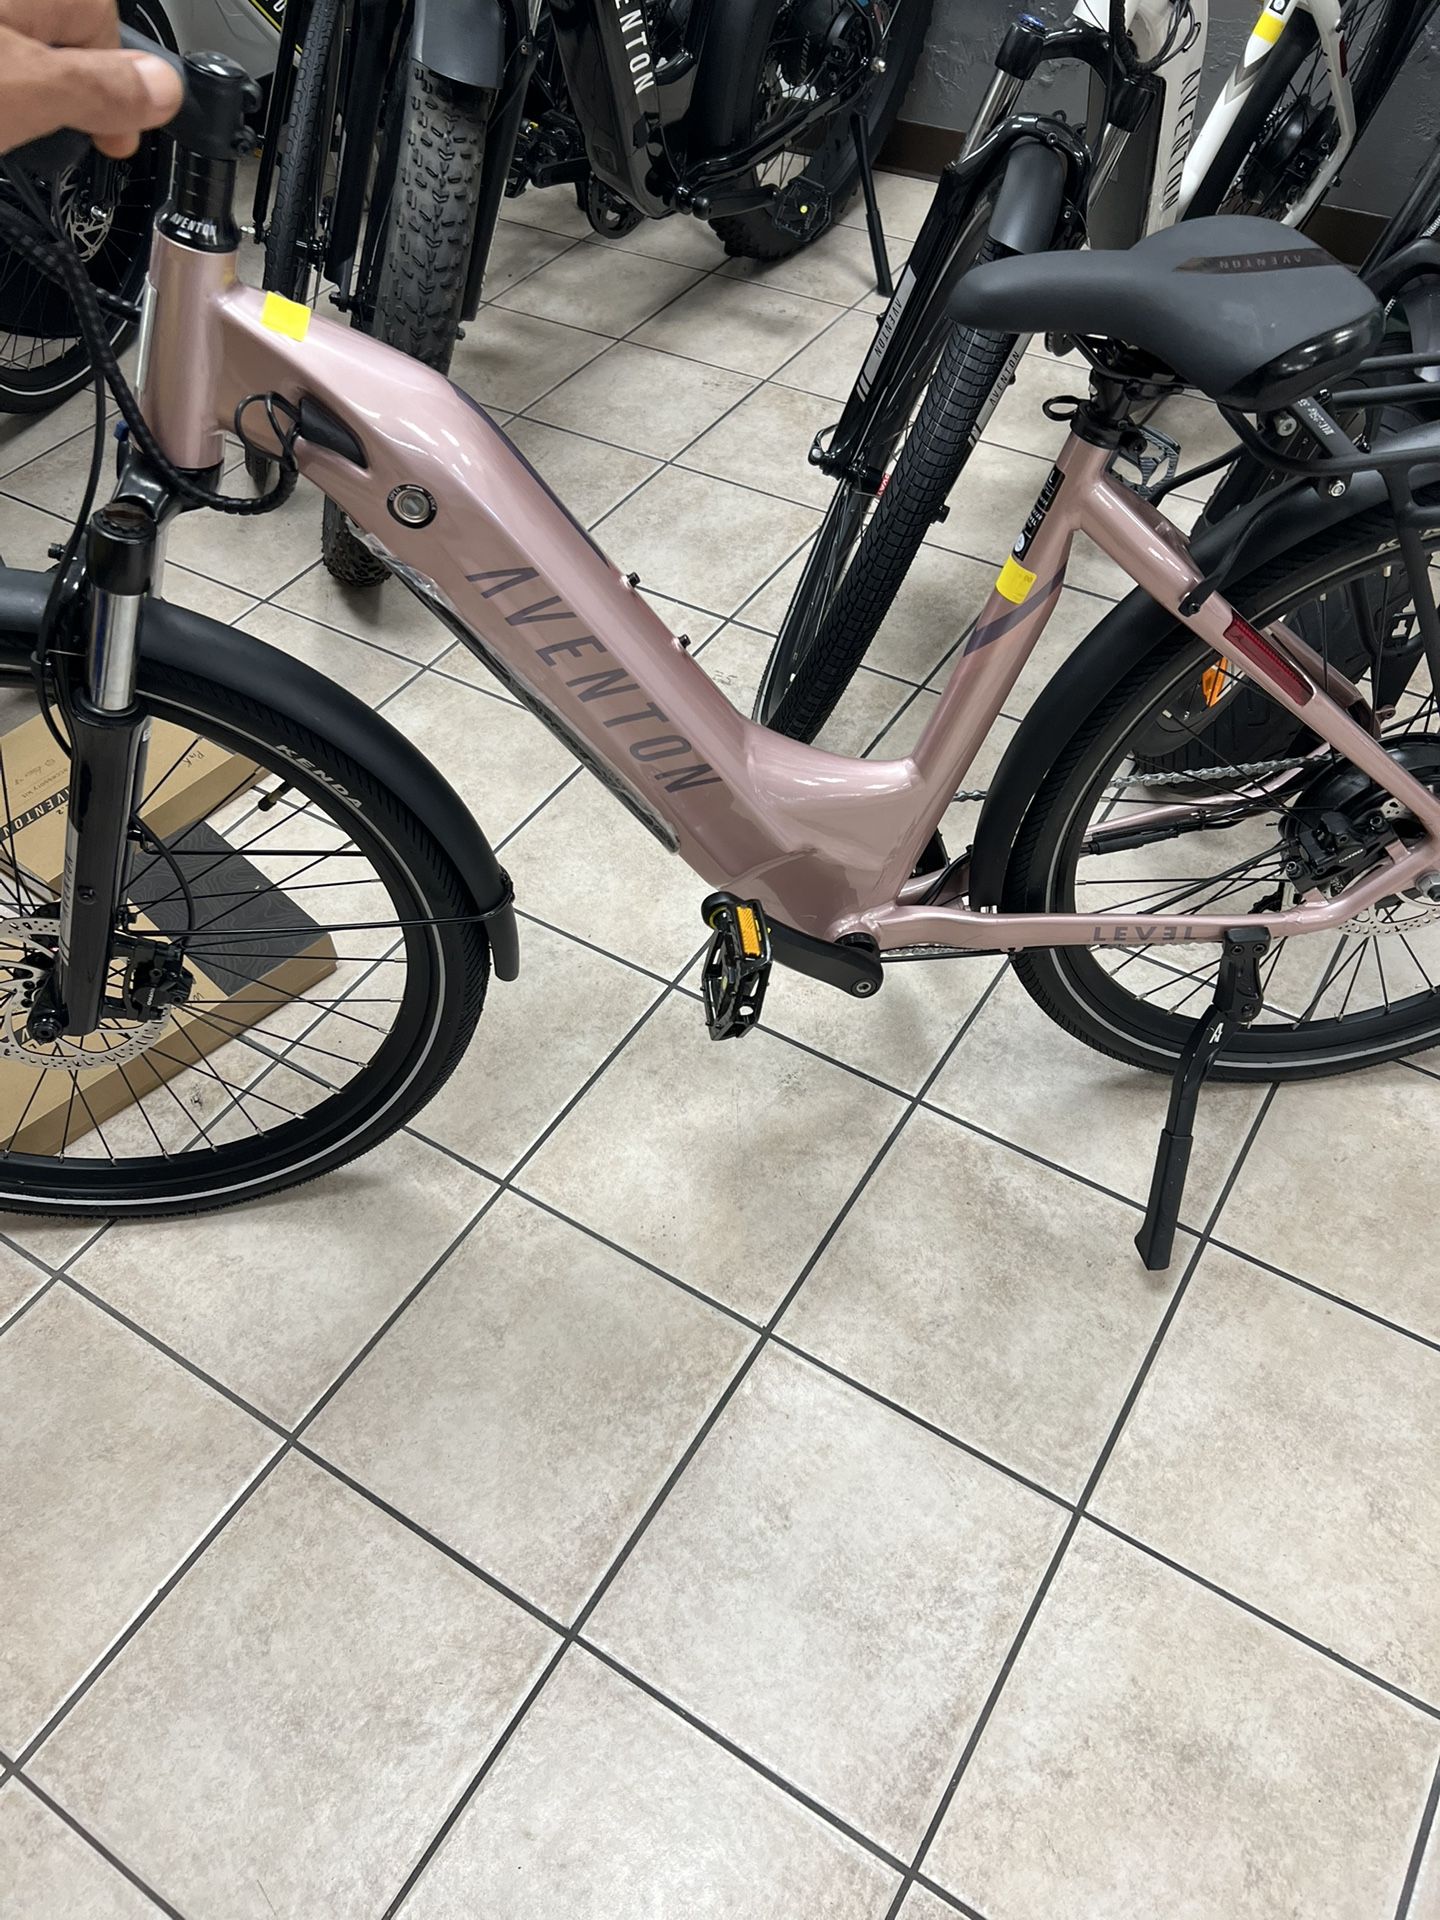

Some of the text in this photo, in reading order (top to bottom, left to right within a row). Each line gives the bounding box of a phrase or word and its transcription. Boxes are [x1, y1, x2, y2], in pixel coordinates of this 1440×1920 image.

[1160, 67, 1201, 212] AVENTON
[874, 298, 902, 358] AVENTON
[989, 351, 1020, 407] AVENTON
[465, 566, 723, 794] AVENTON
[275, 744, 362, 808] KENDA
[1093, 926, 1197, 942] LEVEL
